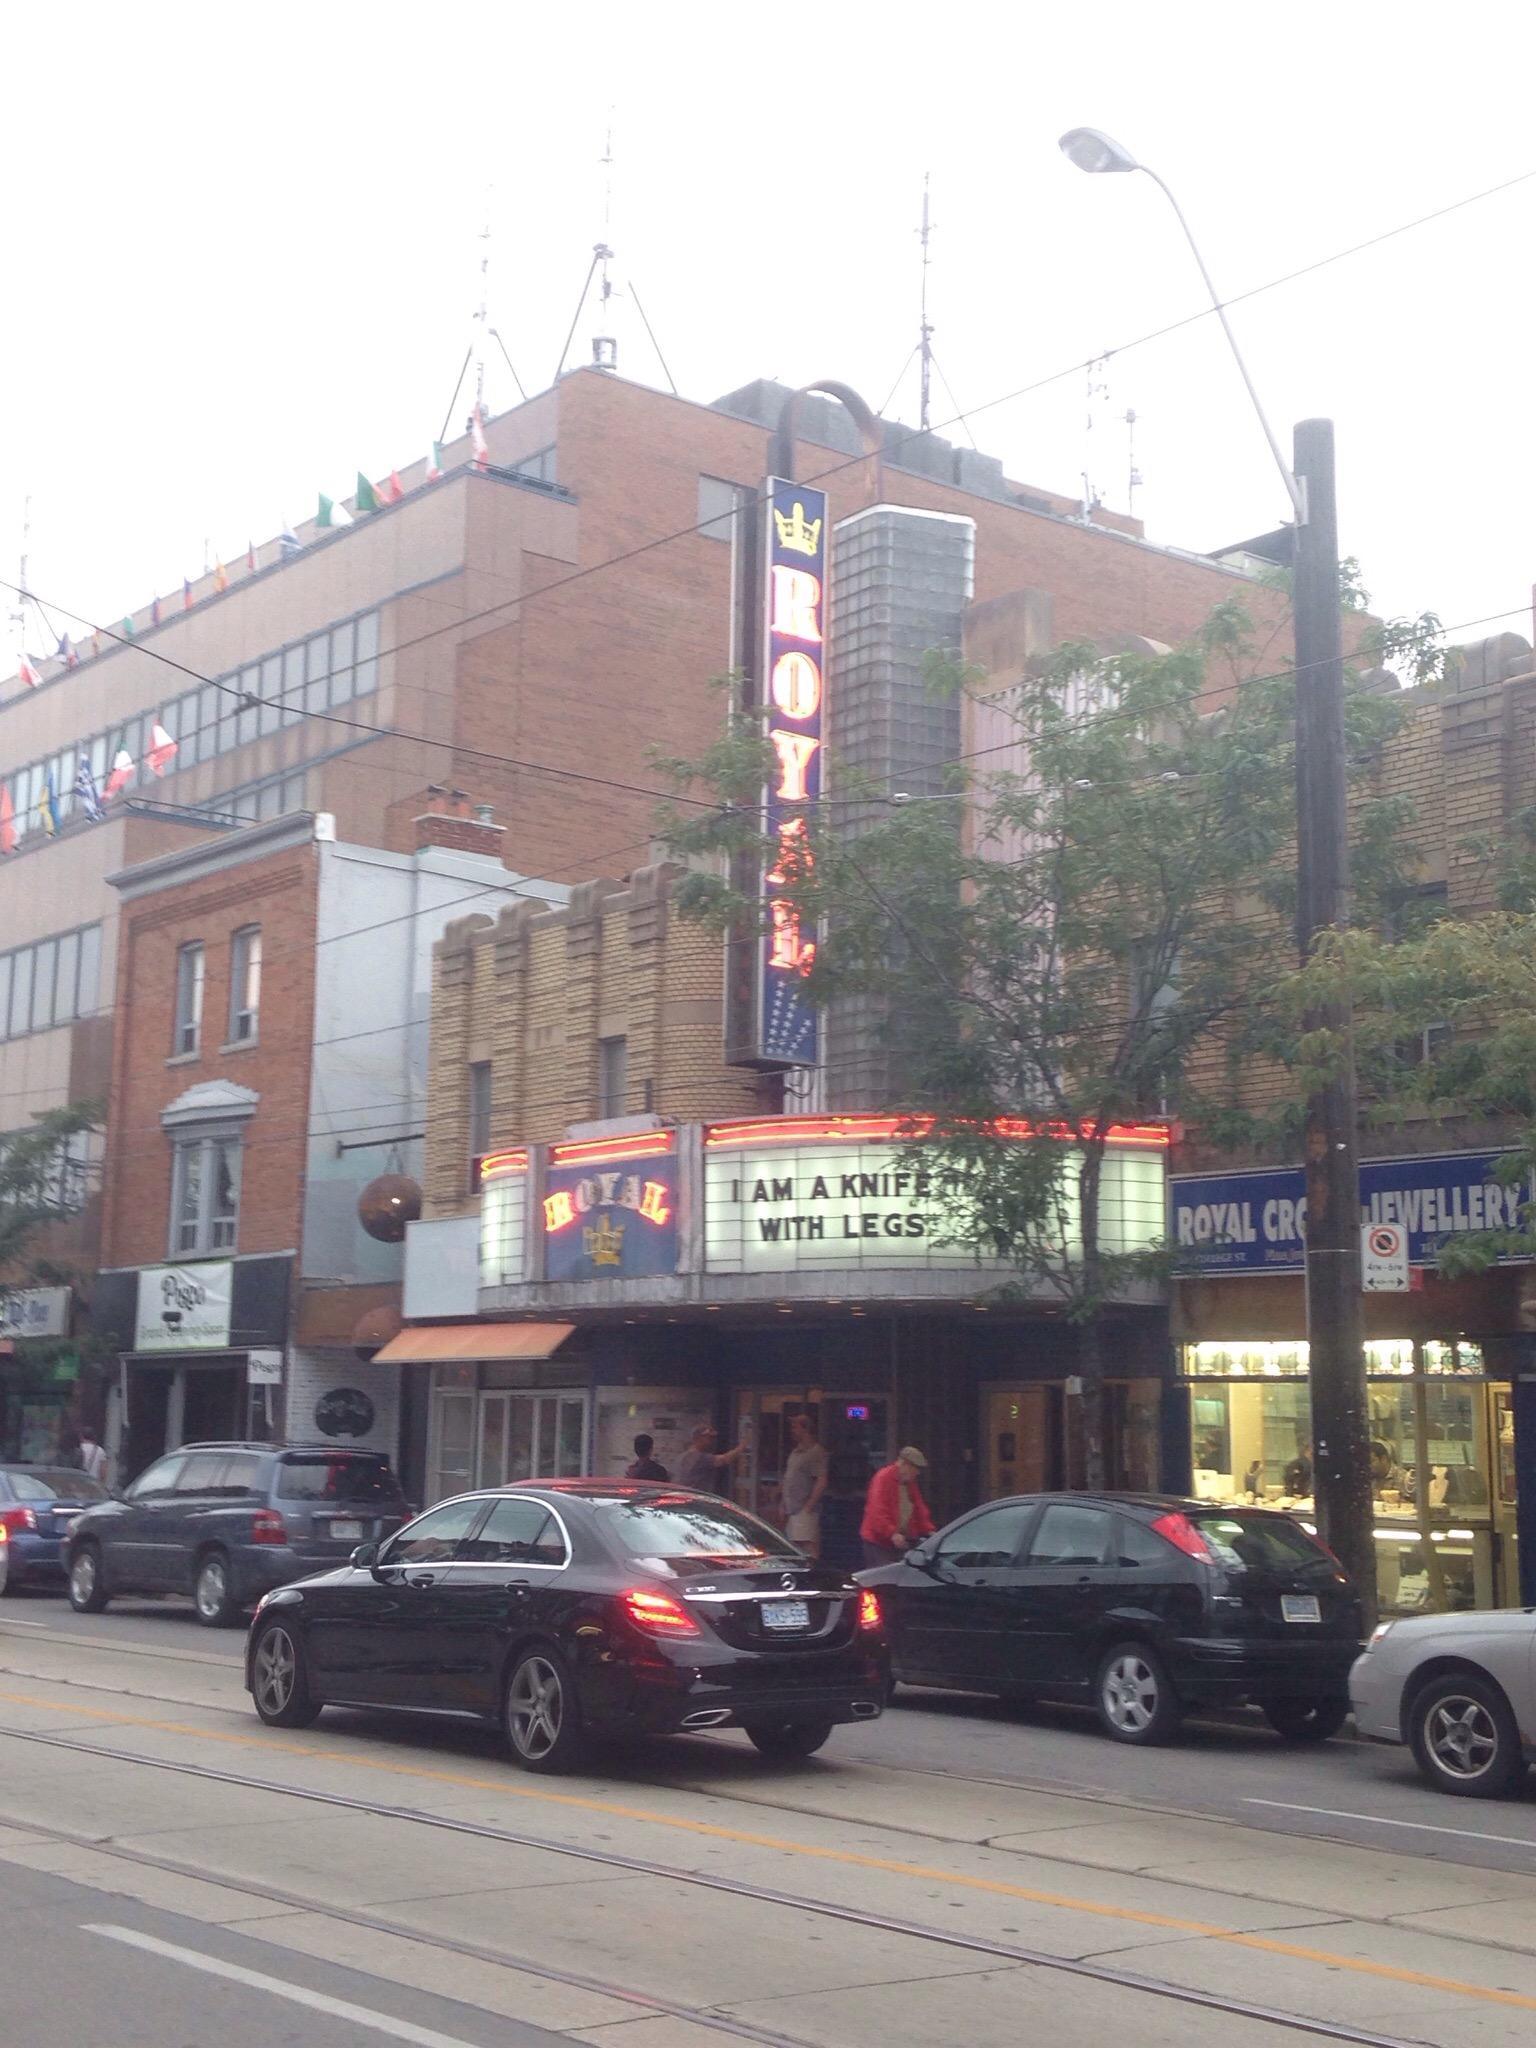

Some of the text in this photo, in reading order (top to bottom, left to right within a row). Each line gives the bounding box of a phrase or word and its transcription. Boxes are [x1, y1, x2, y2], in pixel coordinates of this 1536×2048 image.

[766, 565, 822, 978] ROYAL
[543, 1172, 671, 1232] ROYAL
[732, 1173, 931, 1202] I AM A KNIFE
[1178, 1183, 1520, 1246] ROYAL CRO JEWELLERY
[760, 1213, 925, 1241] WITH LEGS
